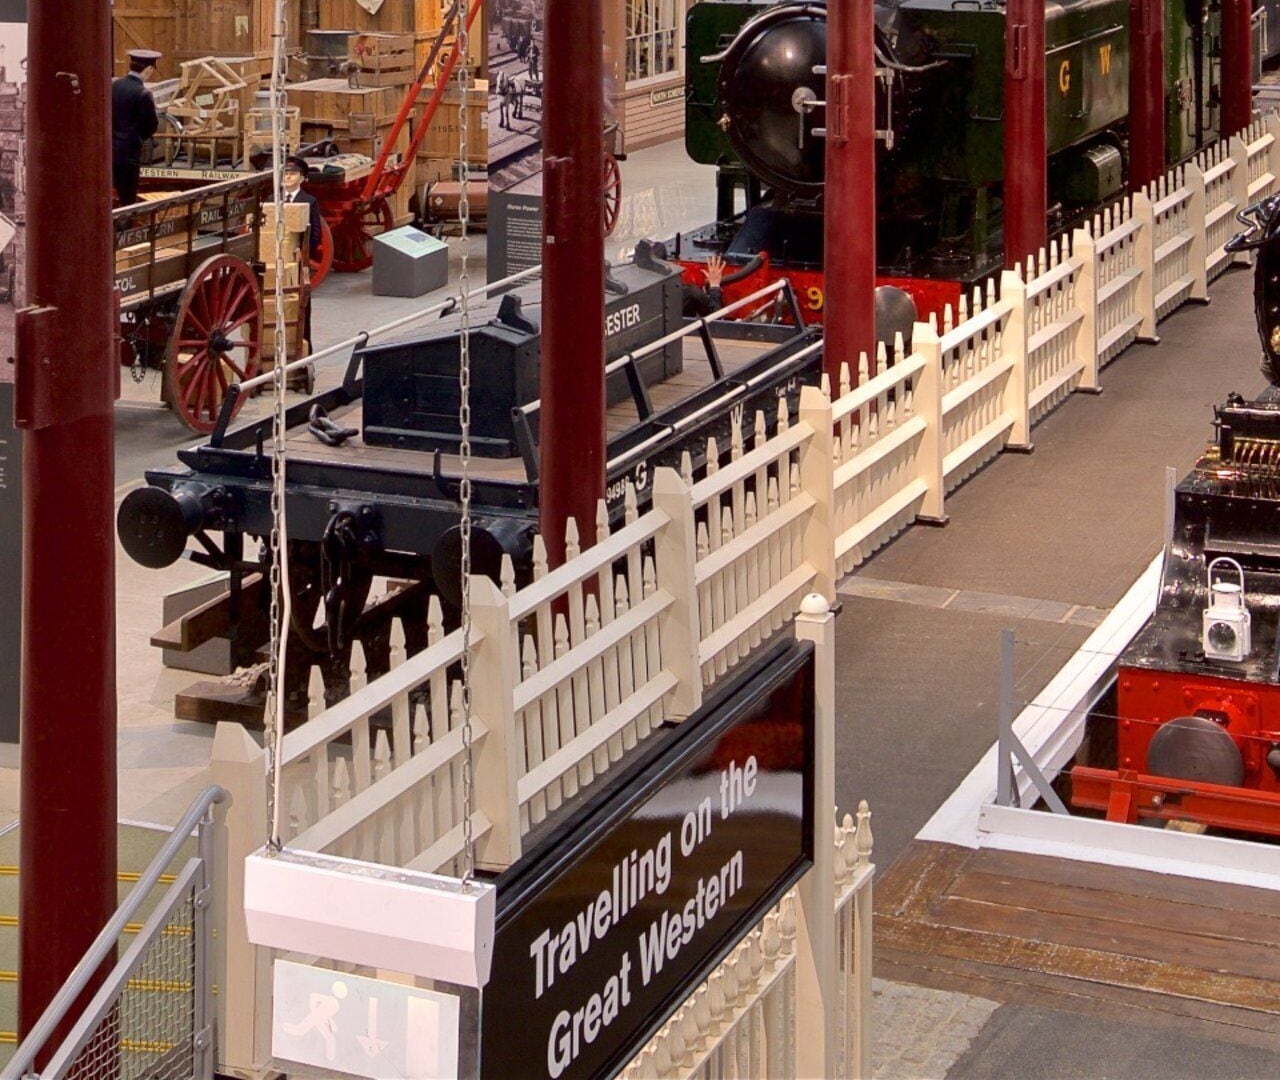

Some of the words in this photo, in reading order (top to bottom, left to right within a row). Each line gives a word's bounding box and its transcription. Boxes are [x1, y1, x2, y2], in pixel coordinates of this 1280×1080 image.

[1059, 60, 1070, 92] G
[1099, 44, 1112, 75] W
[605, 303, 641, 337] ESTER
[635, 460, 648, 490] G
[530, 830, 674, 1000] Travelling
[679, 796, 713, 858] on
[719, 754, 759, 821] the
[546, 951, 632, 1080] Great
[638, 849, 745, 989] Western
